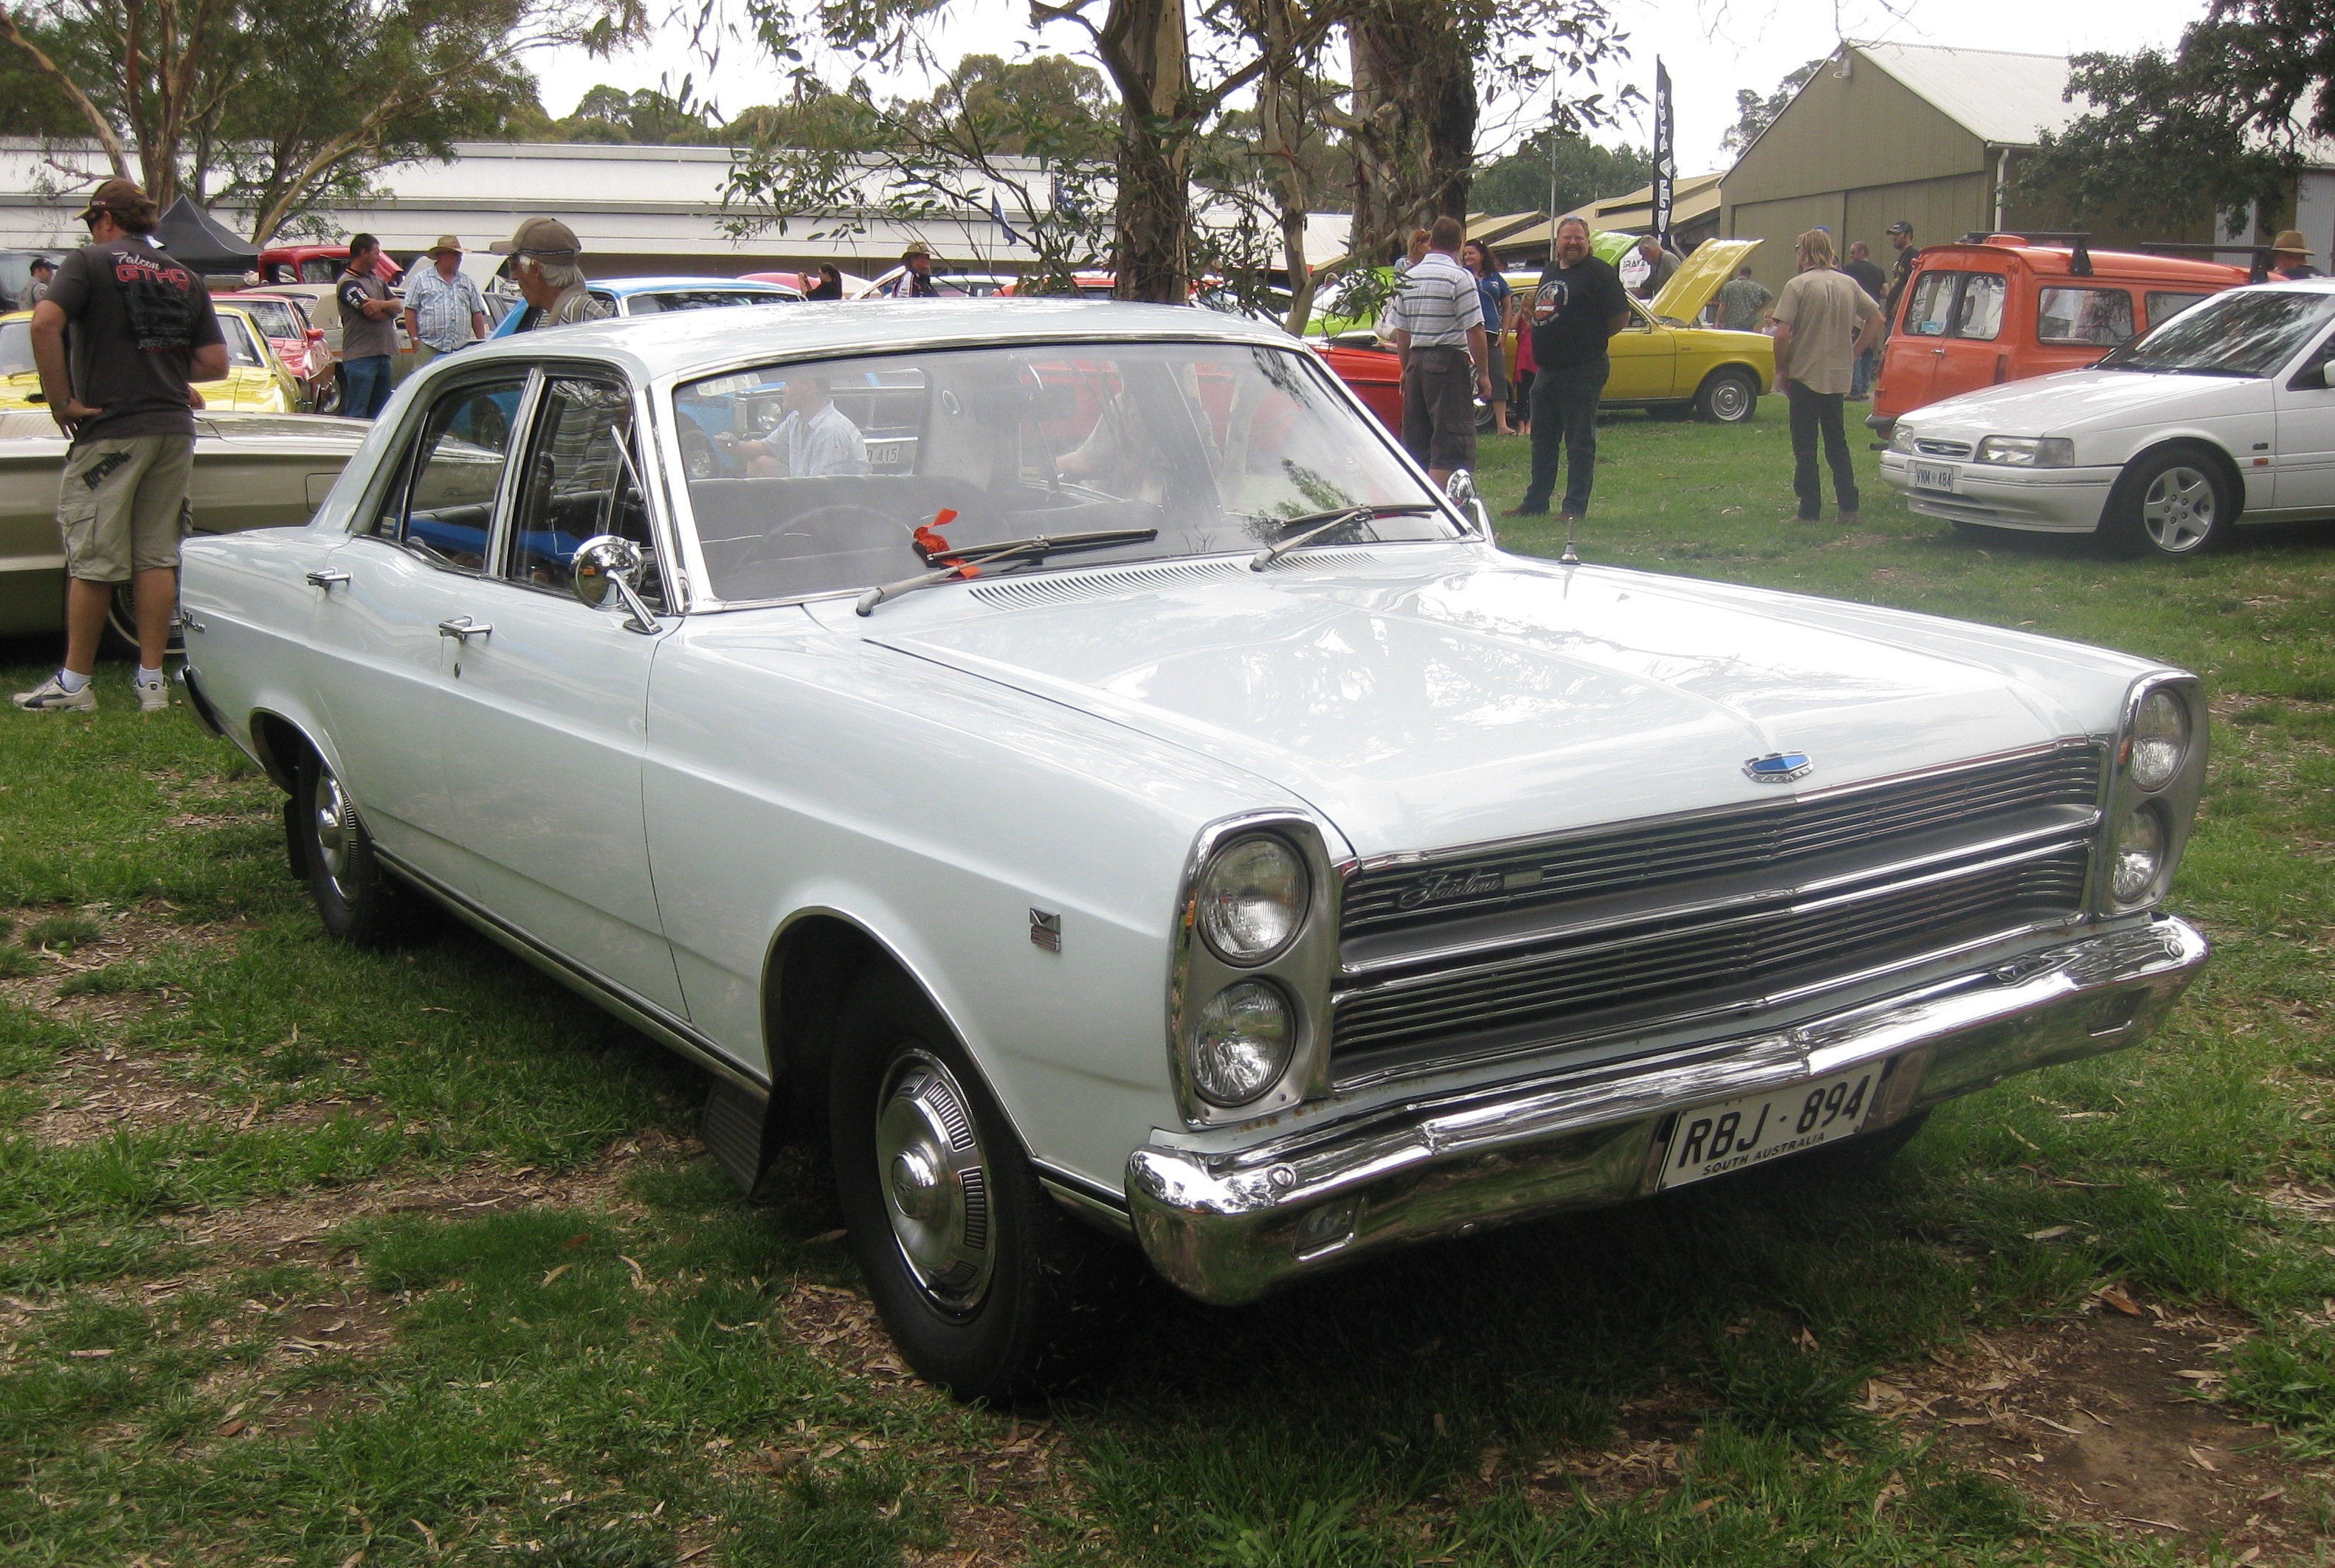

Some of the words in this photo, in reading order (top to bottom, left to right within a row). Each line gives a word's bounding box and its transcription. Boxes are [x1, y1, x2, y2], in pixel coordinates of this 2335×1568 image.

[1658, 89, 1673, 244] STANG
[111, 251, 161, 271] Falcon
[116, 264, 190, 283] GTHO
[1917, 469, 1931, 484] VNM
[1938, 472, 1951, 488] 484
[1677, 1102, 1771, 1168] RBJ
[1796, 1074, 1872, 1133] 894
[1702, 1153, 1748, 1175] SOUTH
[1753, 1132, 1825, 1162] AUSTRALIA
